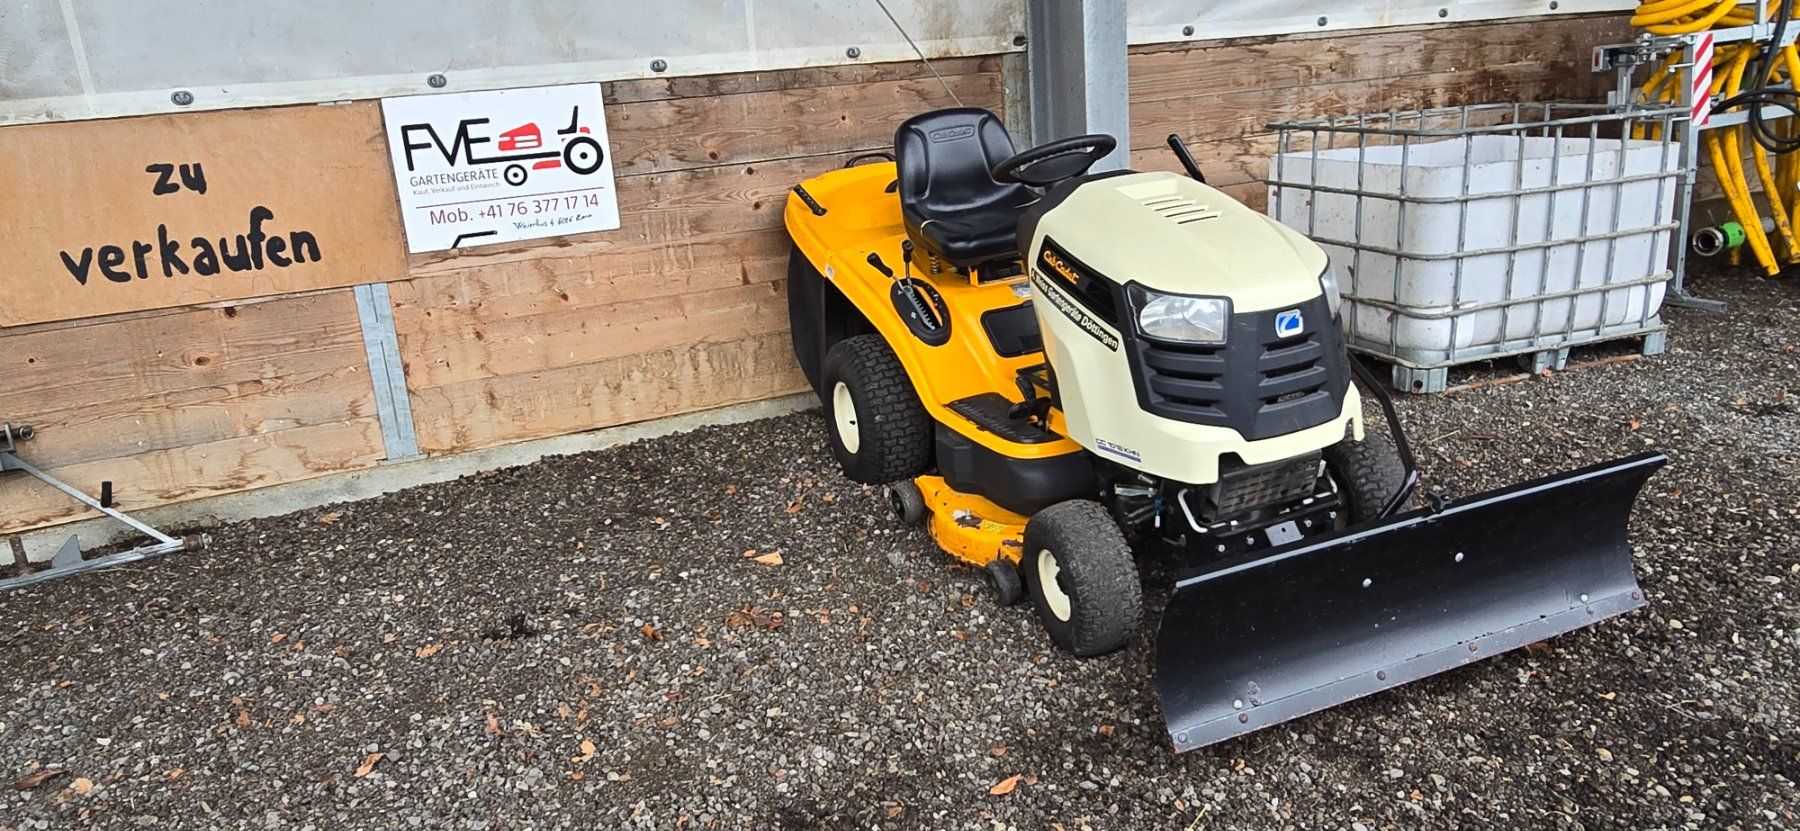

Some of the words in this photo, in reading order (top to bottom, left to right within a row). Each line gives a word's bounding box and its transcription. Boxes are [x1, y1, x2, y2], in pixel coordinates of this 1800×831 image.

[400, 118, 490, 171] FVE
[146, 162, 207, 195] zu
[410, 168, 499, 187] GARTENGERÄTE
[431, 185, 456, 195] Verkauf
[457, 183, 470, 192] und
[430, 207, 473, 225] Mob.
[478, 204, 503, 219] +41
[507, 201, 528, 216] 76
[532, 198, 559, 214] 377
[564, 196, 578, 210] 17
[583, 194, 599, 208] 14
[60, 205, 322, 285] verkaufen
[1081, 316, 1118, 349] Döttingen
